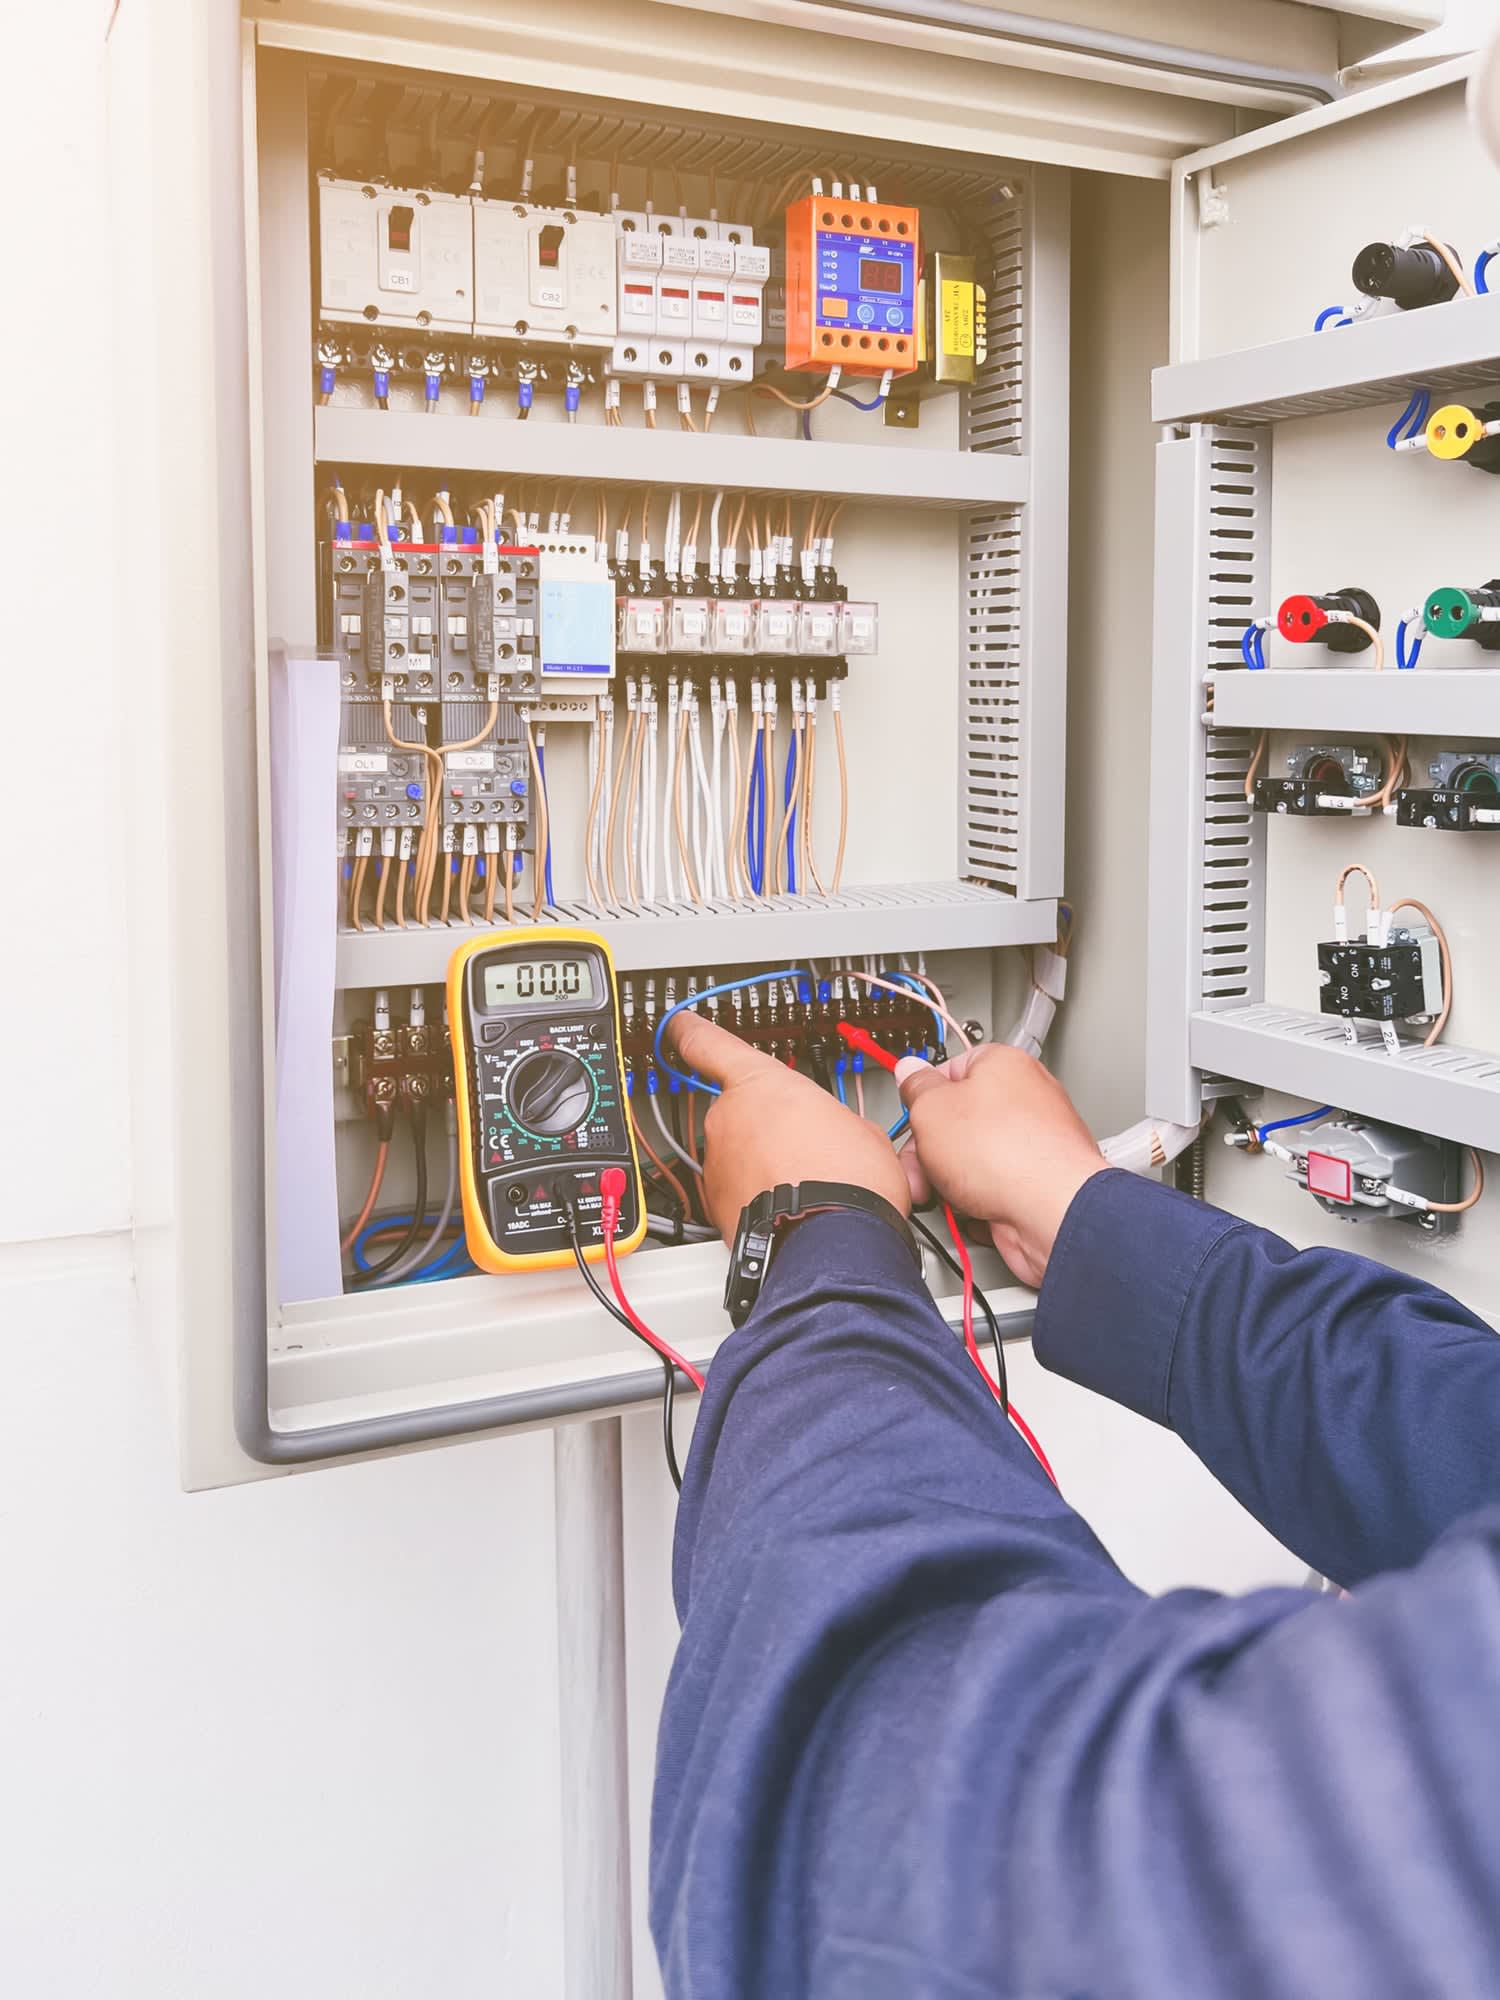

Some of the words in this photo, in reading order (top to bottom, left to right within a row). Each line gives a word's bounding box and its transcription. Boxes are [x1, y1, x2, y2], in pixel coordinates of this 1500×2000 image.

[391, 275, 409, 285] CB1
[542, 292, 561, 303] CB2
[736, 311, 756, 320] CON
[354, 760, 375, 769] OL1
[465, 756, 486, 766] OL2
[1282, 782, 1295, 791] NC
[1432, 794, 1447, 803] NO
[1351, 964, 1359, 978] NO
[1340, 986, 1349, 1000] NO
[489, 1134, 510, 1150] CE
[508, 1220, 530, 1230] 10ADC
